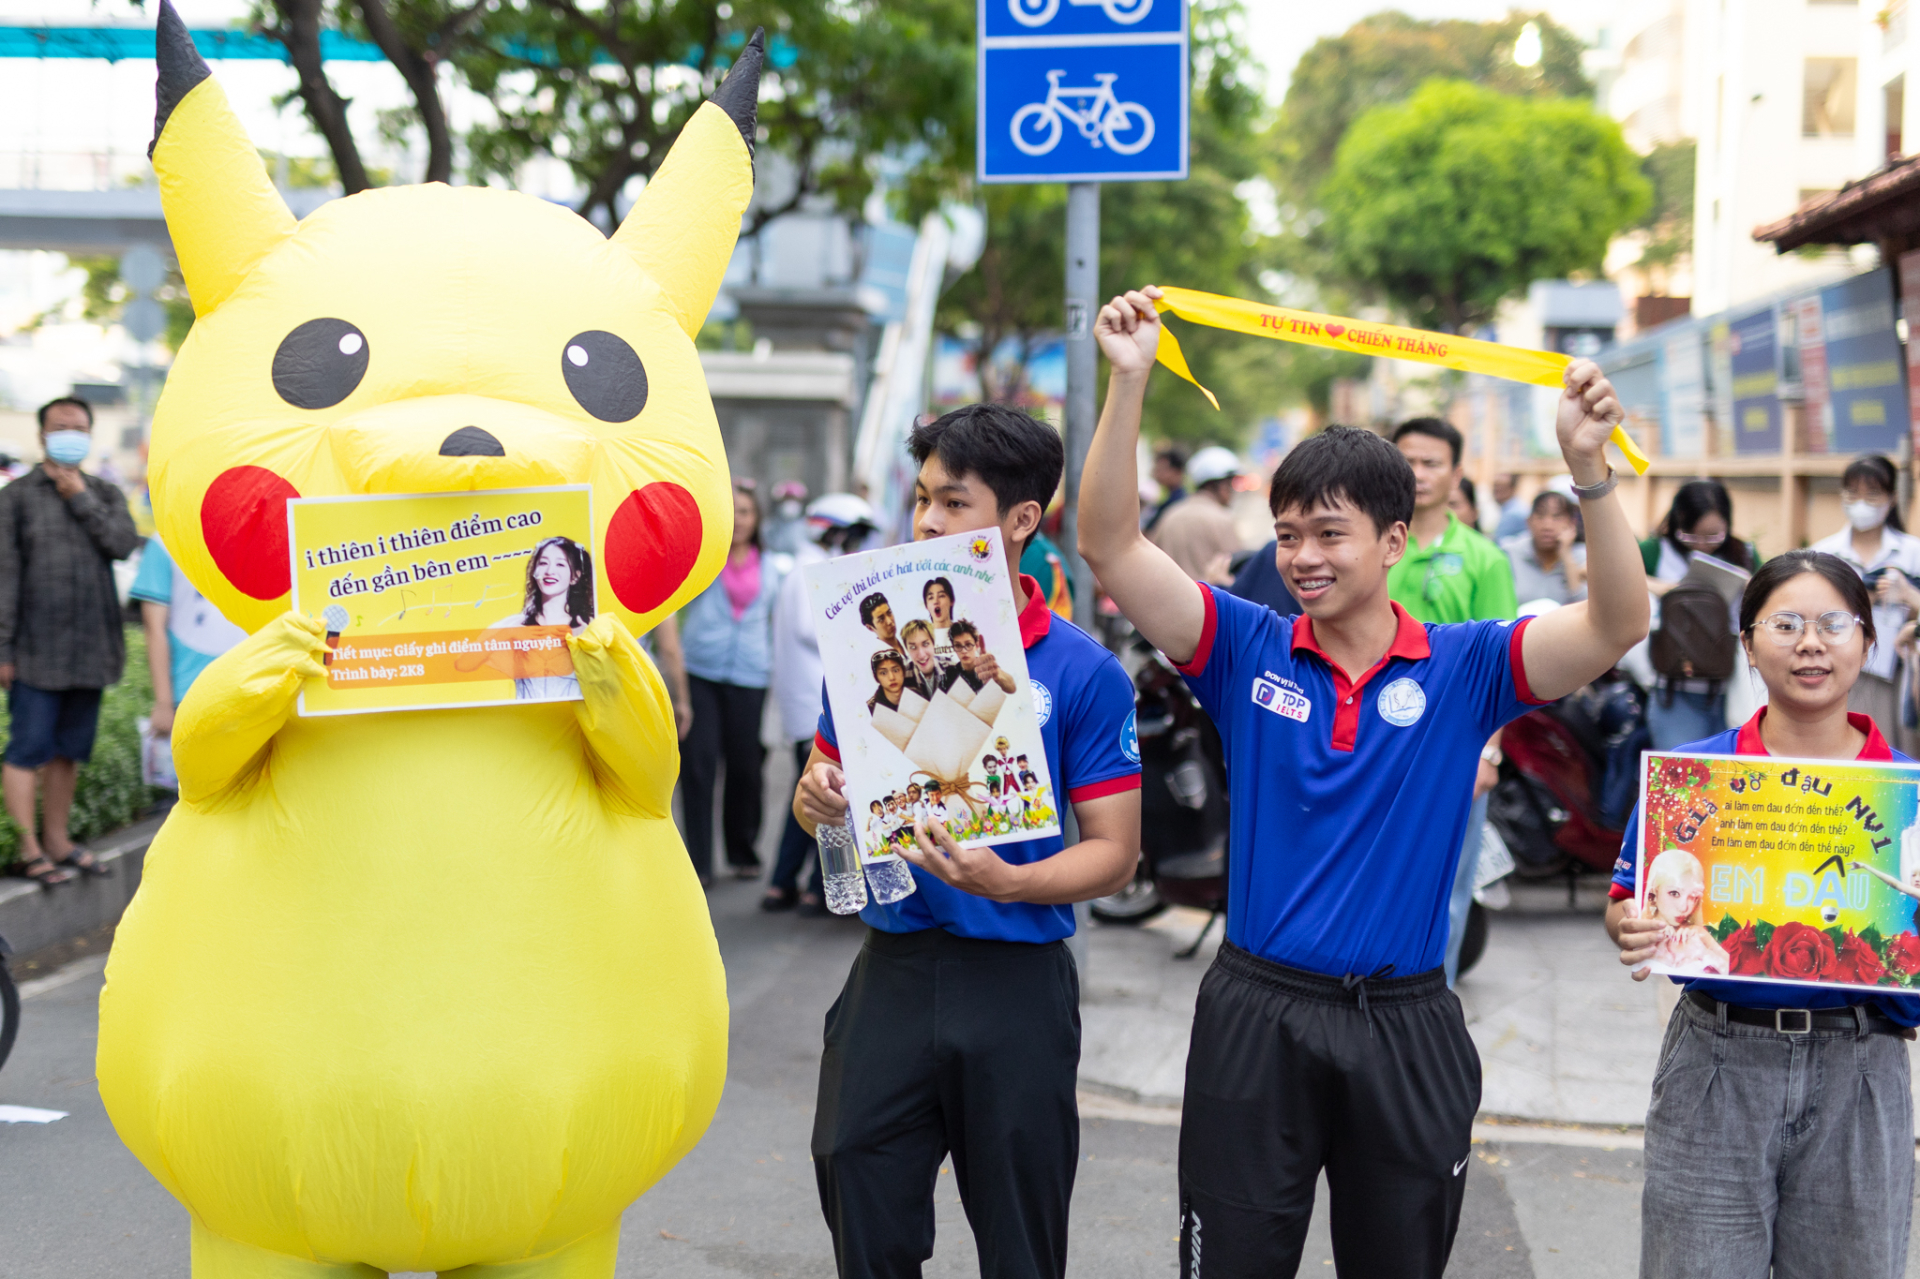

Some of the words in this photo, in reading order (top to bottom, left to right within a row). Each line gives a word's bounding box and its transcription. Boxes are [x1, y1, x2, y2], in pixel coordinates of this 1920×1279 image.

[1260, 313, 1286, 334] TỰ
[1290, 319, 1322, 337] TIN
[1347, 328, 1394, 348] CHIẾN
[1397, 334, 1448, 357] THẮNG
[306, 550, 315, 568] i
[317, 542, 376, 566] thiên
[378, 536, 387, 554] i
[389, 527, 447, 552] thiên
[450, 514, 503, 540] điểm
[507, 511, 542, 529] cao
[330, 572, 369, 597] đến
[372, 565, 411, 593] gần
[411, 560, 452, 581] bên
[456, 555, 489, 572] em
[934, 558, 951, 571] các
[953, 565, 974, 577] anh
[974, 570, 996, 584] nhé
[359, 647, 392, 661] mục:
[394, 641, 424, 658] Giấy
[425, 641, 447, 657] ghi
[448, 638, 482, 653] điểm
[484, 638, 511, 651] tâm
[513, 635, 562, 651] nguyện
[331, 666, 368, 681] Trình
[370, 666, 398, 680] bày:
[399, 664, 425, 677] 2K8
[1276, 704, 1303, 719] IELTS
[1725, 800, 1733, 811] ai
[1734, 800, 1750, 812] làm
[1751, 803, 1765, 812] em
[1766, 802, 1783, 813] đau
[1784, 803, 1804, 814] đớn
[1806, 802, 1822, 815] đến
[1824, 804, 1844, 816] thế?
[1720, 819, 1735, 829] anh
[1737, 819, 1753, 830] làm
[1755, 822, 1768, 831] em
[1770, 821, 1786, 831] đau
[1788, 821, 1808, 833] đớn
[1810, 821, 1826, 834] đến
[1828, 823, 1848, 835] thế?
[1711, 836, 1725, 847] Em
[1727, 837, 1743, 848] làm
[1744, 840, 1758, 849] em
[1759, 839, 1775, 850] đau
[1777, 840, 1797, 851] đớn
[1799, 839, 1815, 852] đến
[1817, 840, 1832, 853] thế
[1834, 844, 1855, 857] này?
[1710, 864, 1764, 904] EM
